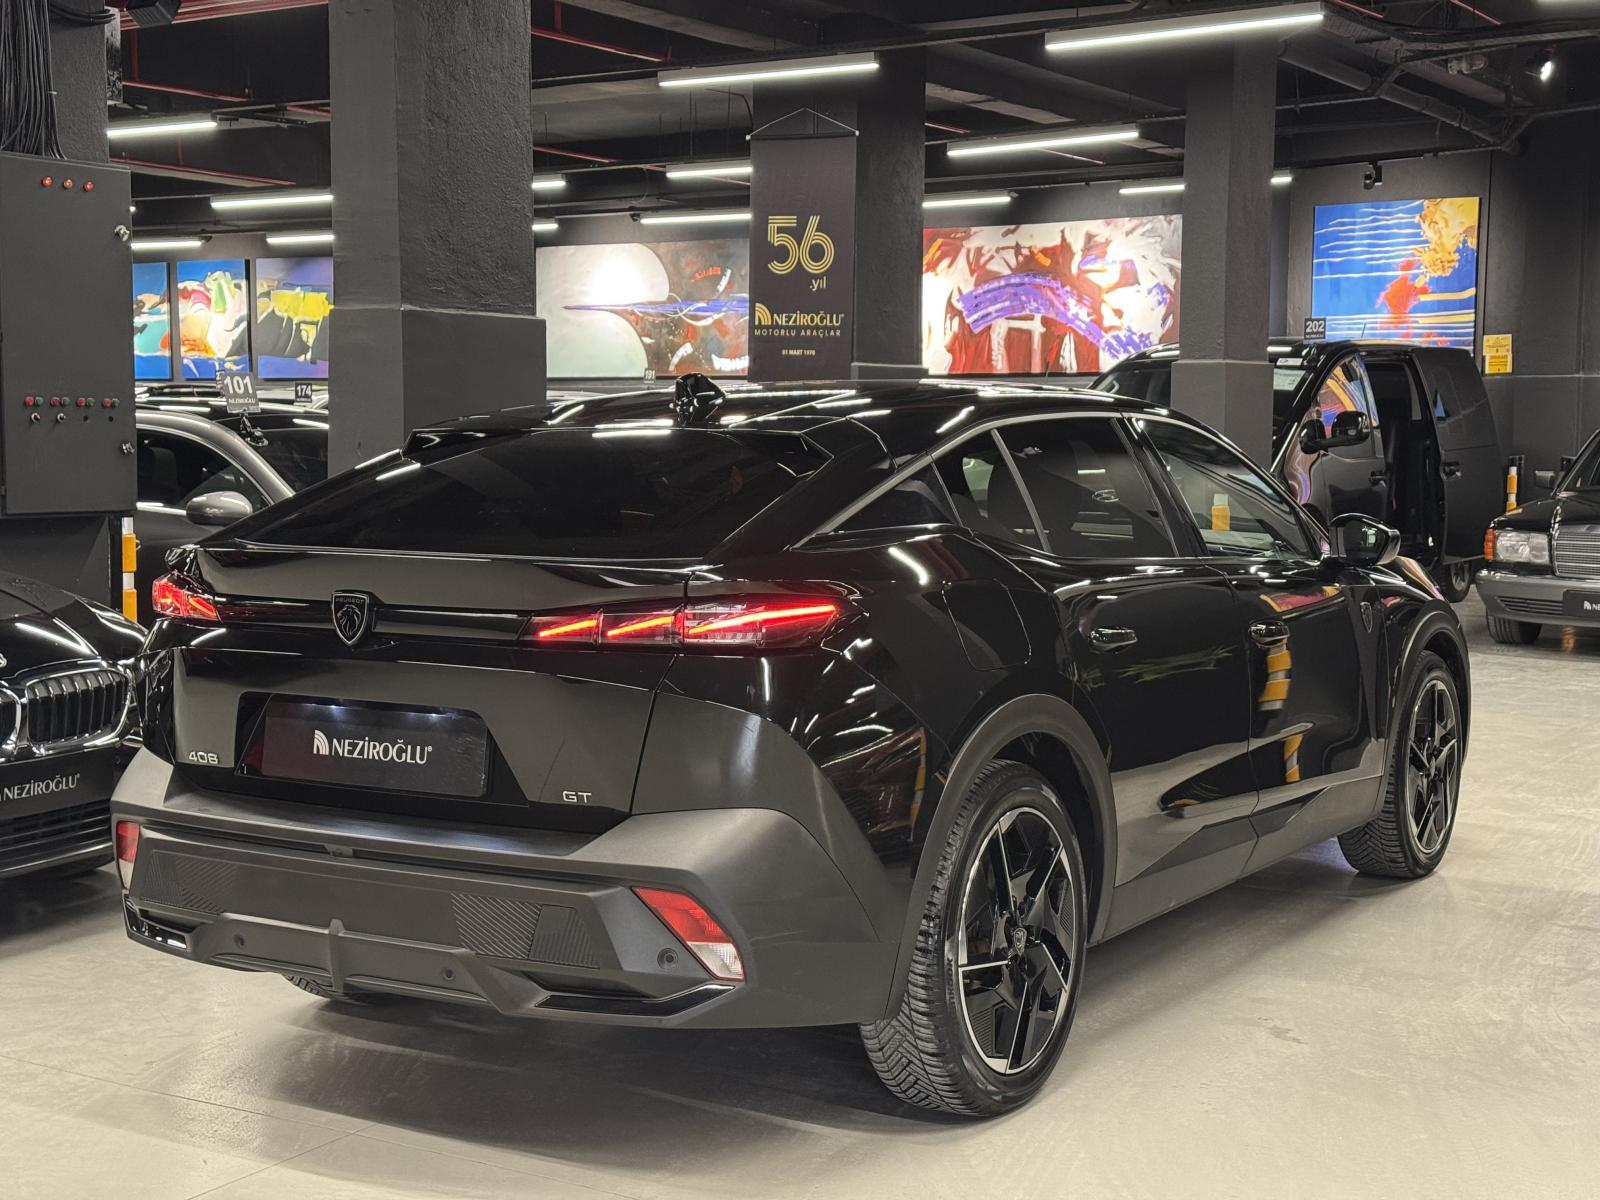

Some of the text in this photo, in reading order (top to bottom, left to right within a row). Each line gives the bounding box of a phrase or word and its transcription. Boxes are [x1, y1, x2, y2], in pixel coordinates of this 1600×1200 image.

[768, 215, 834, 274] 56
[1305, 320, 1325, 332] 202
[754, 328, 841, 339] MOTORLU ARAÇLAR
[224, 375, 253, 394] 101
[296, 384, 312, 396] 174
[189, 751, 218, 764] 408
[562, 790, 592, 803] GT
